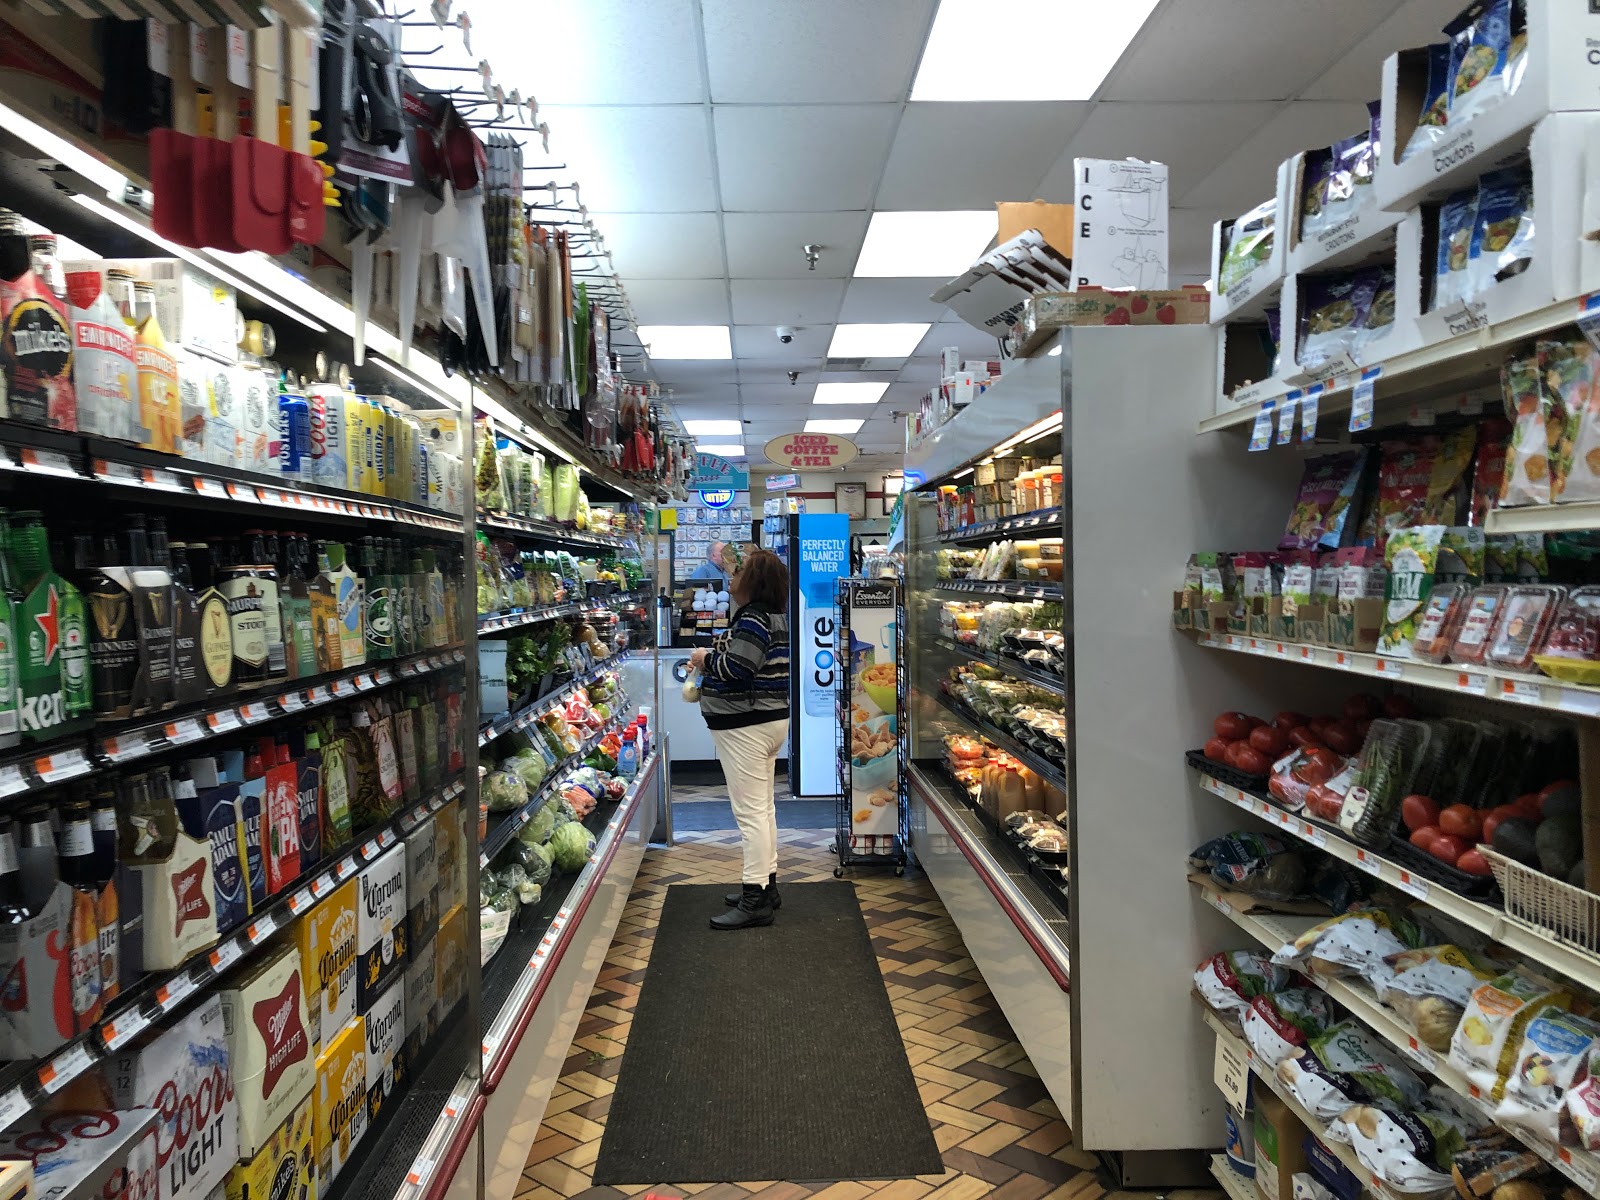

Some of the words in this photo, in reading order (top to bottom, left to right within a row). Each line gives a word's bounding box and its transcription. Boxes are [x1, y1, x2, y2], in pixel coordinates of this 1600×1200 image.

[309, 394, 327, 460] Coors
[327, 404, 339, 449] LIGHT
[793, 435, 829, 446] ICED
[783, 445, 839, 455] COFFEE
[790, 456, 802, 467] &
[803, 456, 832, 466] TEA
[802, 539, 847, 551] PERFECTLY
[802, 550, 845, 562] BALANCED
[810, 561, 839, 573] WATER
[855, 590, 892, 600] Essential
[814, 616, 835, 688] core
[366, 871, 402, 919] Corona
[185, 897, 204, 913] LIFE
[380, 904, 393, 920] Extra
[267, 994, 294, 1049] Miller
[369, 999, 402, 1056] Corona
[268, 1043, 288, 1072] HIGH
[286, 1029, 301, 1054] LIFE
[169, 1113, 225, 1198] LIGHT
